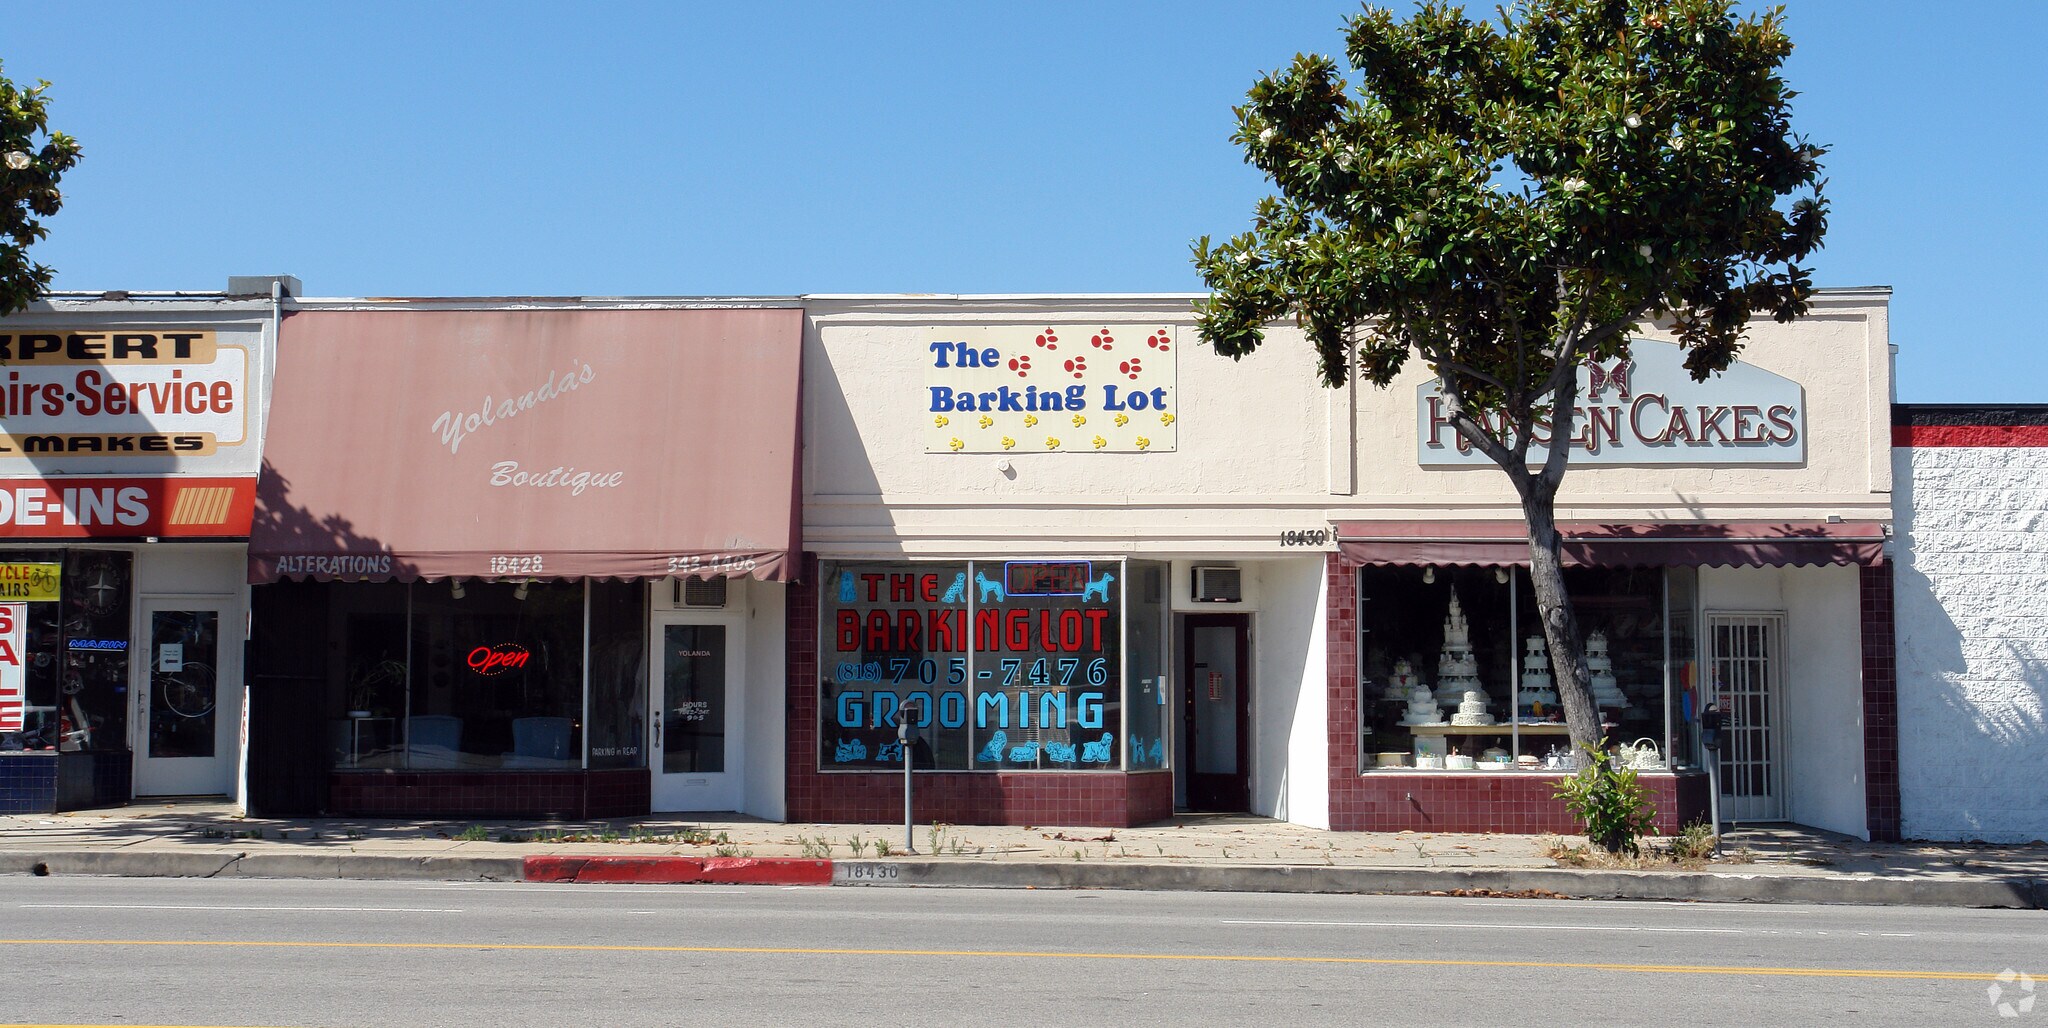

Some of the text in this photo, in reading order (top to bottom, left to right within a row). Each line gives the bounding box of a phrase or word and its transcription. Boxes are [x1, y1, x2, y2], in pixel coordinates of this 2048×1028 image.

[0, 334, 203, 360] PERT
[929, 341, 1000, 368] The
[0, 370, 65, 416] irs
[432, 358, 596, 454] Yolanda's
[928, 384, 1168, 413] Barking Lot
[1629, 393, 1795, 444] CAKES
[24, 435, 204, 452] MAKES
[490, 461, 623, 496] Boutique
[1280, 529, 1325, 547] 18430
[275, 555, 391, 574] ALTERATIONS
[490, 554, 543, 574] 18428
[861, 573, 938, 602] THE
[1008, 564, 1089, 593] OPEN
[68, 639, 128, 649] MARIN
[837, 609, 1109, 652] BARKING LOT
[467, 646, 530, 674] Open
[836, 662, 883, 684] (818)
[837, 691, 1104, 729] GROOMING
[591, 747, 615, 757] PARKING
[622, 746, 638, 756] REAR
[846, 863, 899, 879] 18430
